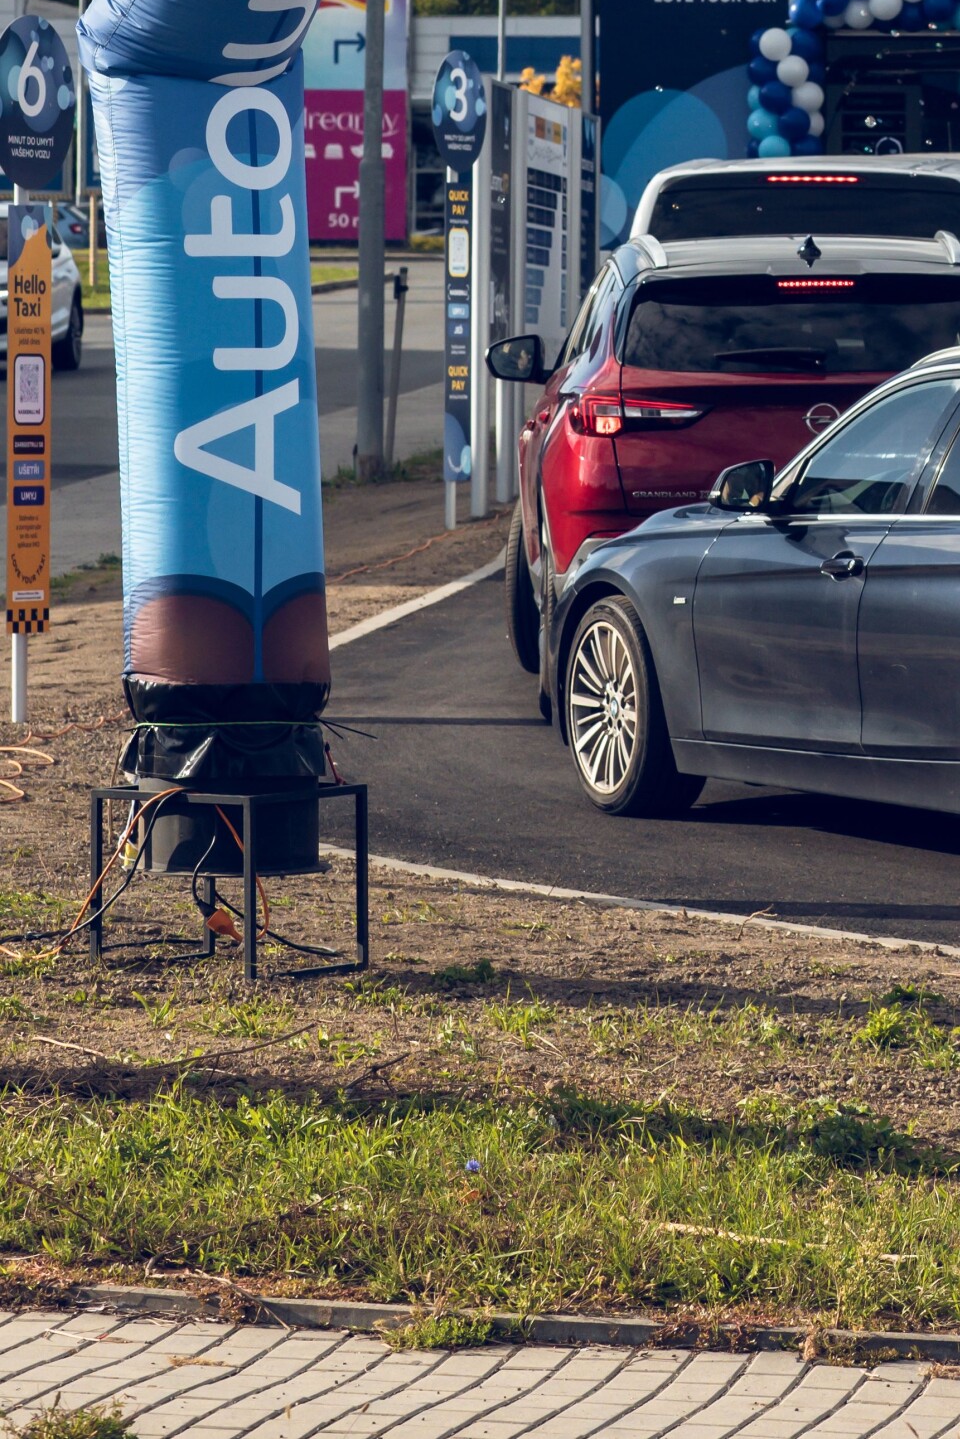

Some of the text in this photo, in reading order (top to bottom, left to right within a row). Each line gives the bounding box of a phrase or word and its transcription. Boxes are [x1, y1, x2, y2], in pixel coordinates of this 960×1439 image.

[17, 40, 47, 117] 6
[449, 67, 468, 122] 3
[8, 135, 26, 145] MINUT
[26, 136, 36, 146] DO
[11, 147, 51, 159] VAŠEHO VOZU
[448, 189, 469, 202] QUICK
[451, 204, 466, 216] PAY
[328, 212, 350, 228] 50
[14, 274, 46, 295] Hello
[13, 297, 41, 317] Taxi
[447, 365, 469, 378] QUICK
[451, 379, 466, 391] PAY
[20, 491, 37, 501] UMYJ
